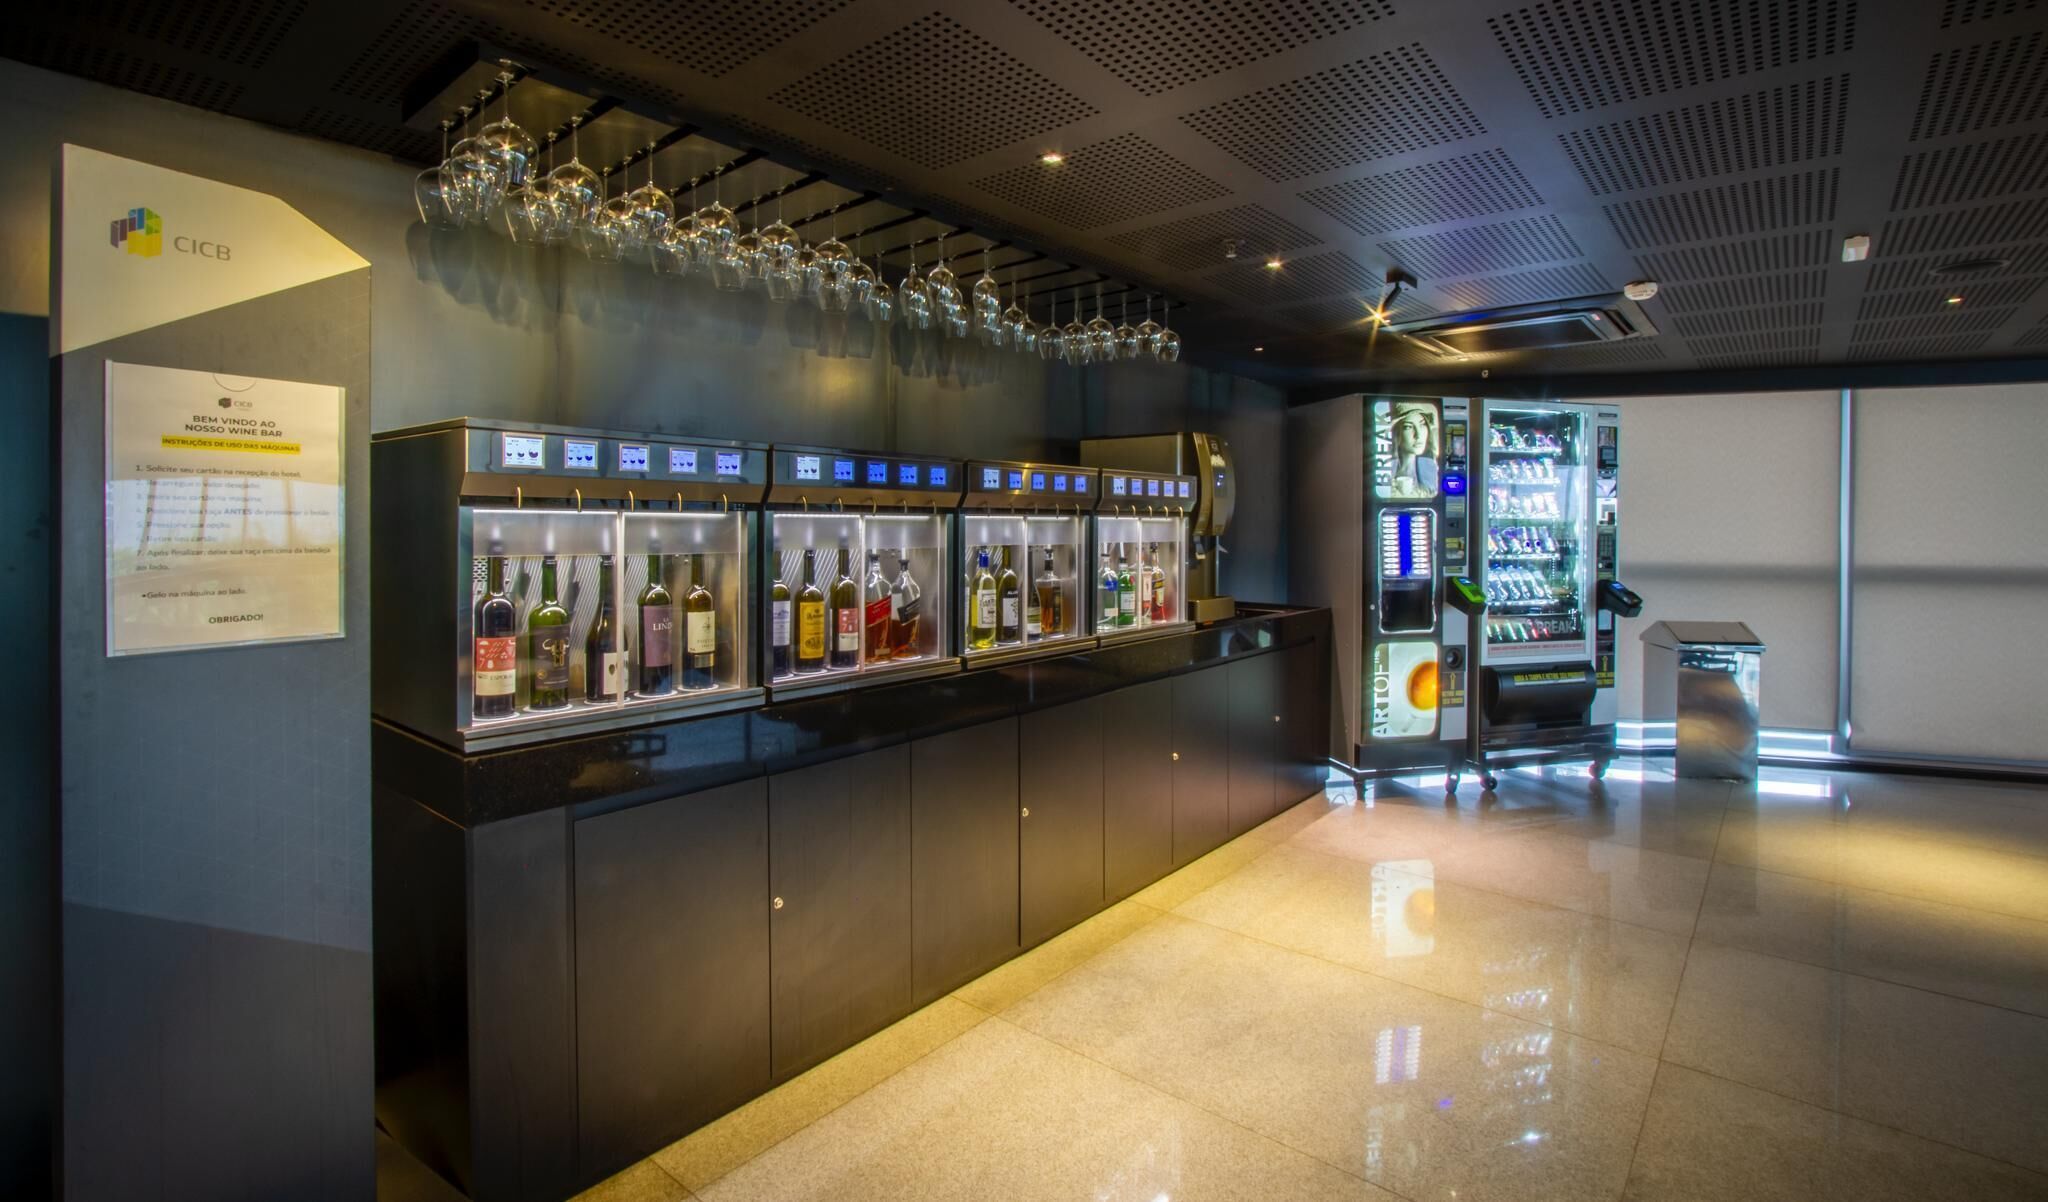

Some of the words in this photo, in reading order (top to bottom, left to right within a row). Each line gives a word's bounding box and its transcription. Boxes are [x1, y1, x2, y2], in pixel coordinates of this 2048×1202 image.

[173, 236, 232, 262] CICB
[193, 415, 218, 424] BEM
[220, 417, 257, 427] VINDO
[260, 420, 276, 428] AO
[185, 424, 225, 433] NOSSO
[228, 427, 258, 436] WINE
[261, 429, 282, 438] BAR
[162, 438, 213, 447] INSTRUÇÕES
[260, 443, 300, 453] MÁQUINAS
[1375, 412, 1393, 486] BREAK
[146, 465, 178, 473] Solicite
[196, 466, 222, 475] cartão
[235, 469, 269, 478] recepção
[224, 508, 252, 516] ANTES
[181, 589, 215, 598] máquina
[208, 614, 264, 624] OBRIGADO!
[1535, 619, 1573, 634] BREAK
